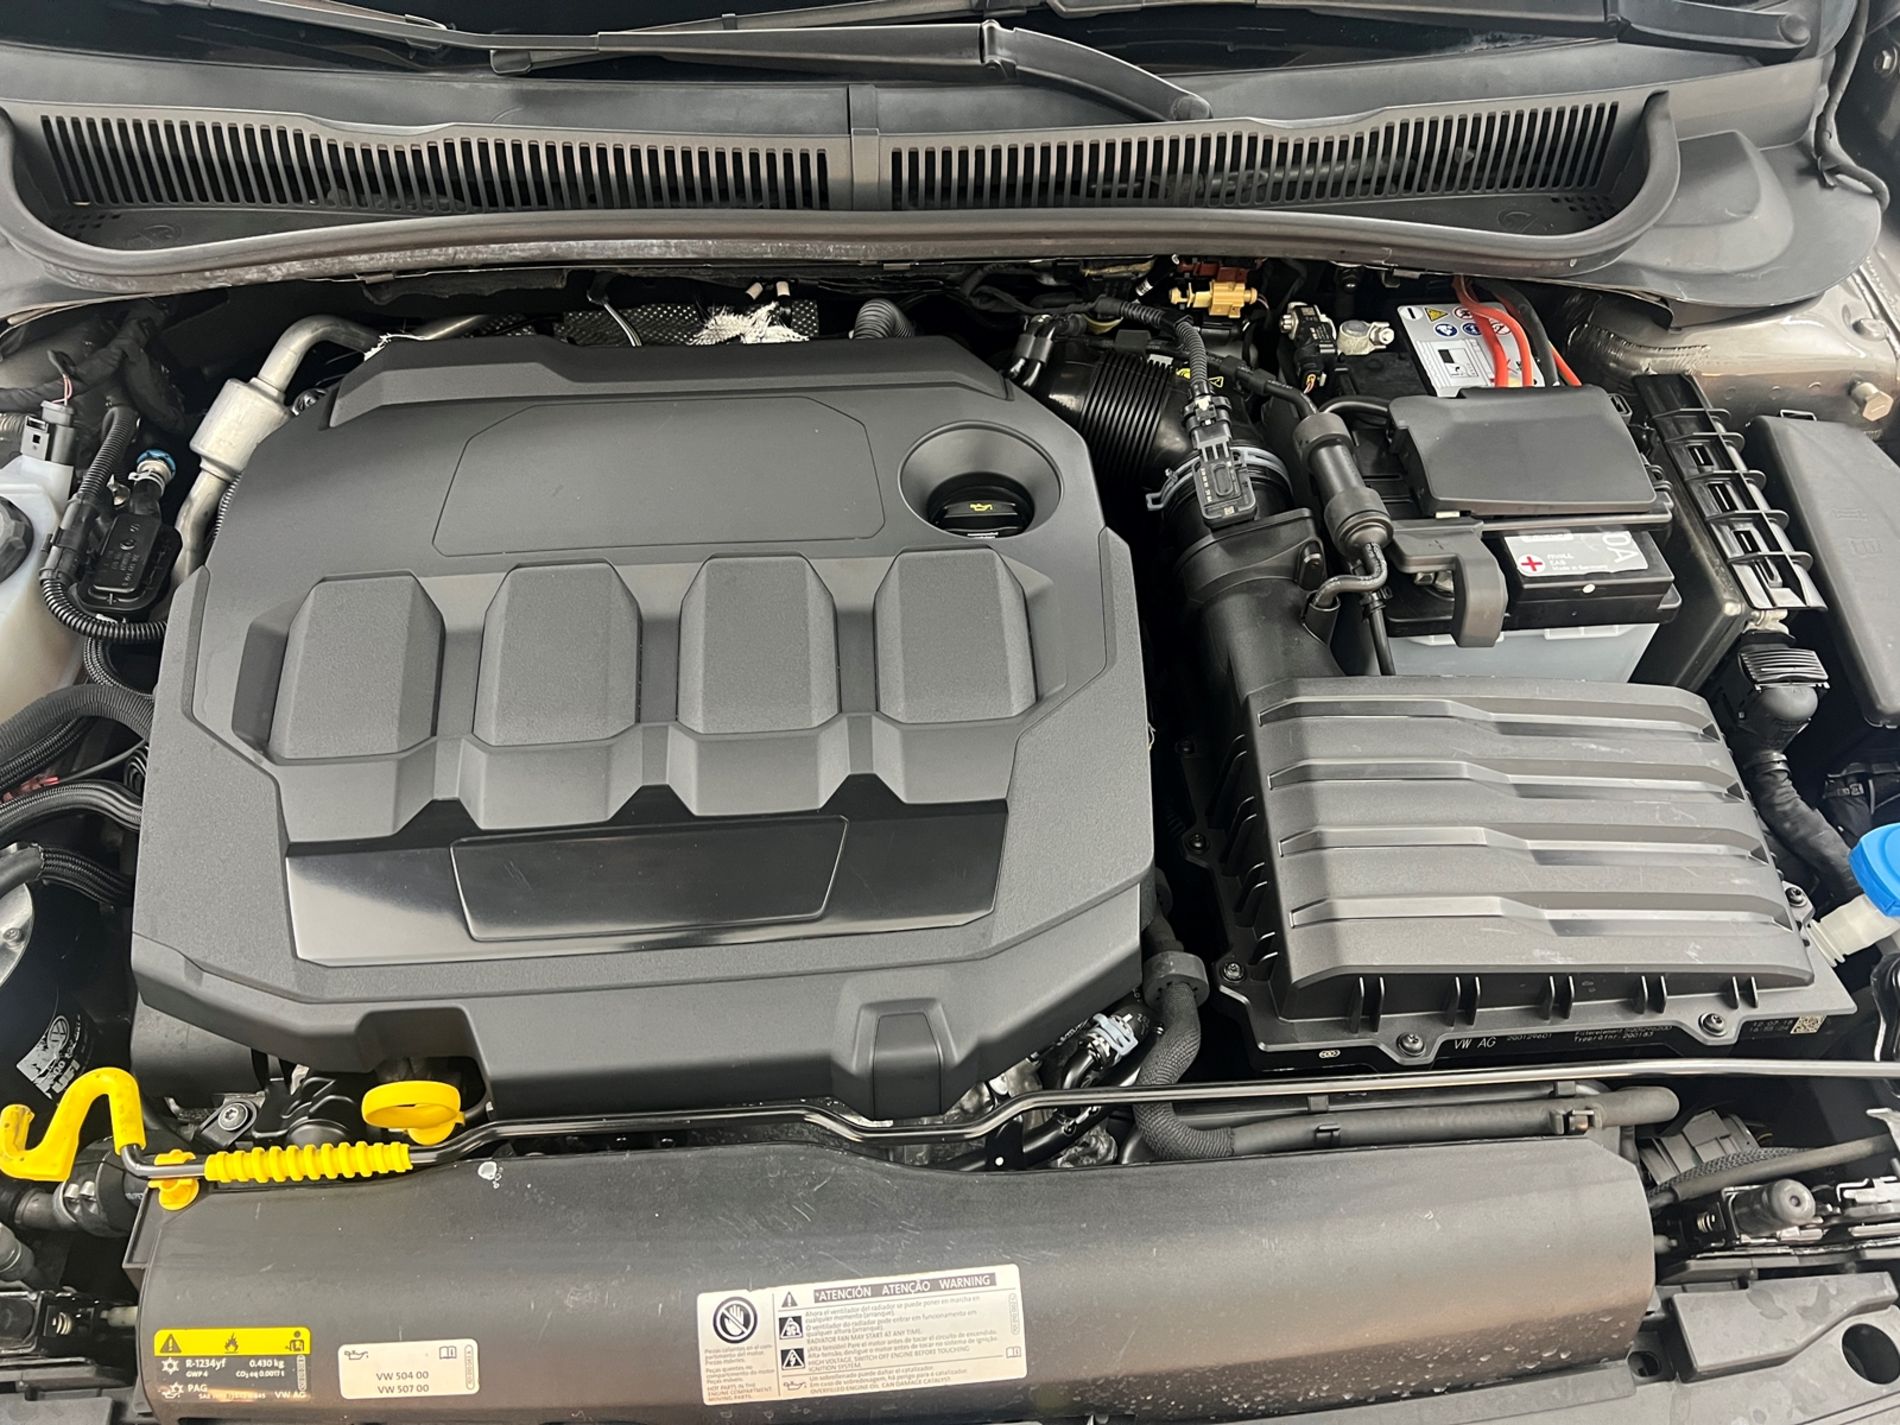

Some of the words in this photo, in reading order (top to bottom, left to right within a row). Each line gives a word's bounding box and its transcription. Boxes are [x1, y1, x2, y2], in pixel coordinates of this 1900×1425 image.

[1454, 1038, 1472, 1049] VW
[1477, 1036, 1497, 1048] AG
[882, 1280, 930, 1296] ATENÇÃO
[939, 1276, 990, 1290] WARNING
[806, 1336, 835, 1344] RADIATOR
[937, 1346, 969, 1354] TOUCHING
[186, 1358, 227, 1370] R-1234yf
[249, 1360, 272, 1368] 0.430
[274, 1360, 284, 1369] kg
[396, 1372, 414, 1380] 504
[416, 1371, 430, 1380] 00
[188, 1384, 208, 1392] PAG
[377, 1386, 394, 1394] VW
[398, 1385, 414, 1394] 507
[416, 1384, 430, 1392] 00
